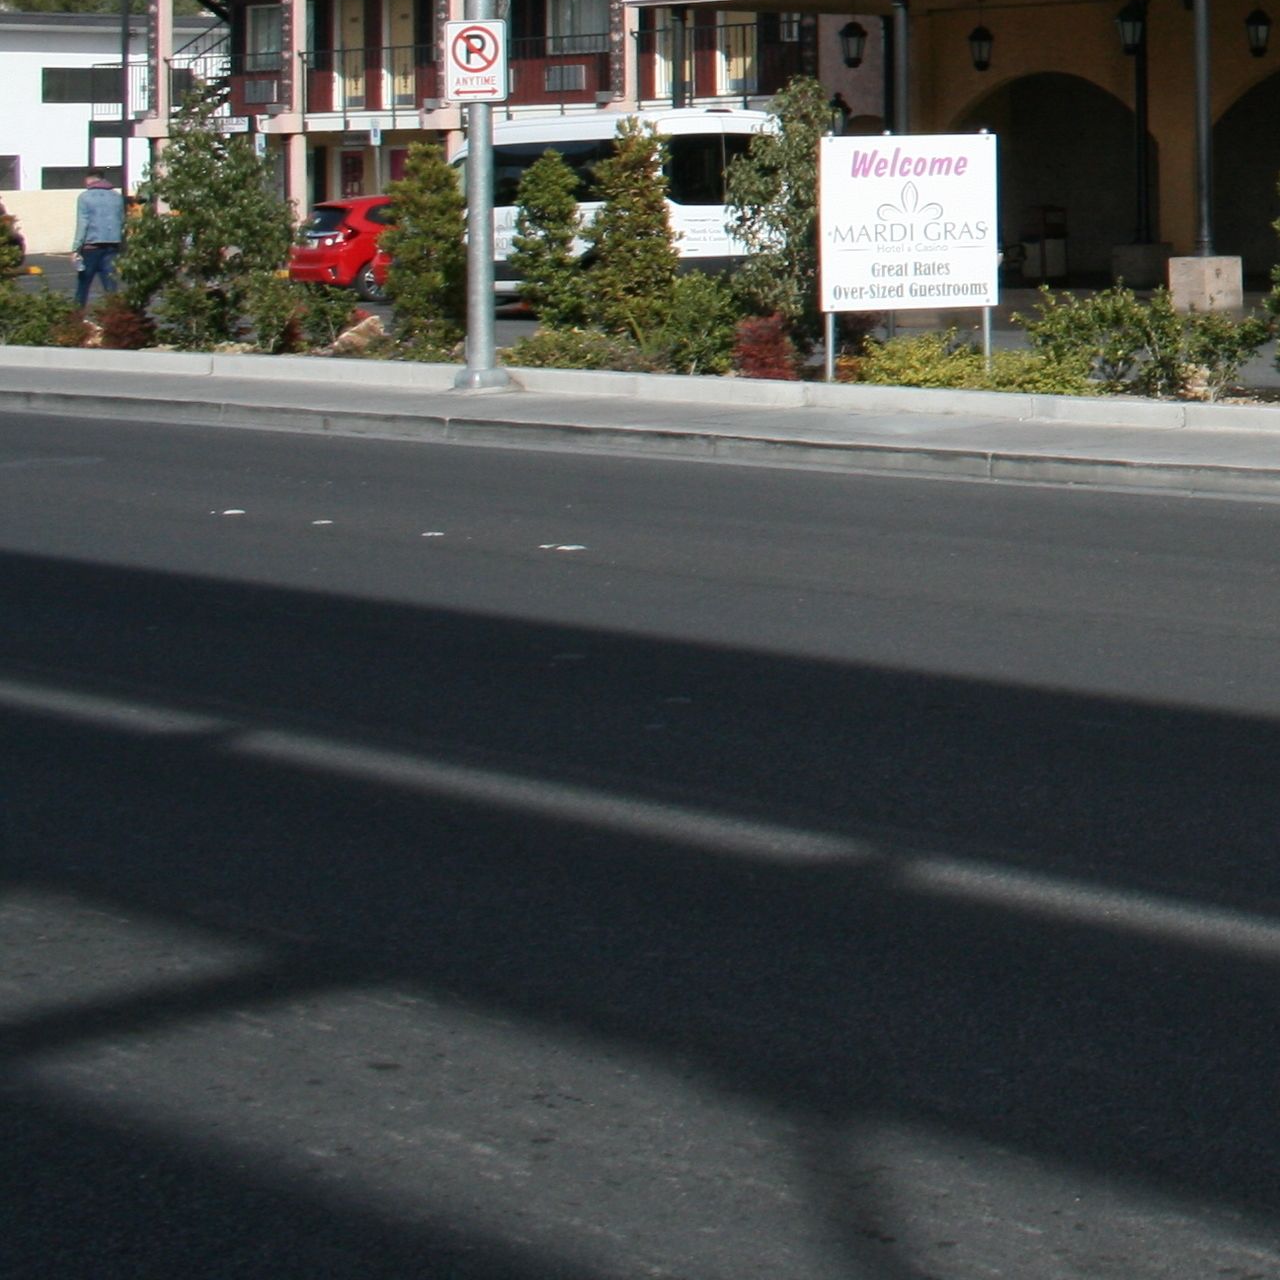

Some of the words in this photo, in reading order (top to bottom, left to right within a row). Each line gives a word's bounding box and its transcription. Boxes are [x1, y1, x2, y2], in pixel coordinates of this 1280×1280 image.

[455, 75, 497, 87] ANYTIME
[851, 147, 968, 178] Welcome
[833, 222, 914, 244] MARDI
[923, 221, 987, 241] GRAS
[876, 244, 904, 254] Hotel
[915, 243, 949, 253] Casino
[871, 262, 909, 277] Great
[913, 261, 951, 276] Rates
[833, 283, 904, 300] Over-Sized
[908, 282, 989, 298] Guestrooms
